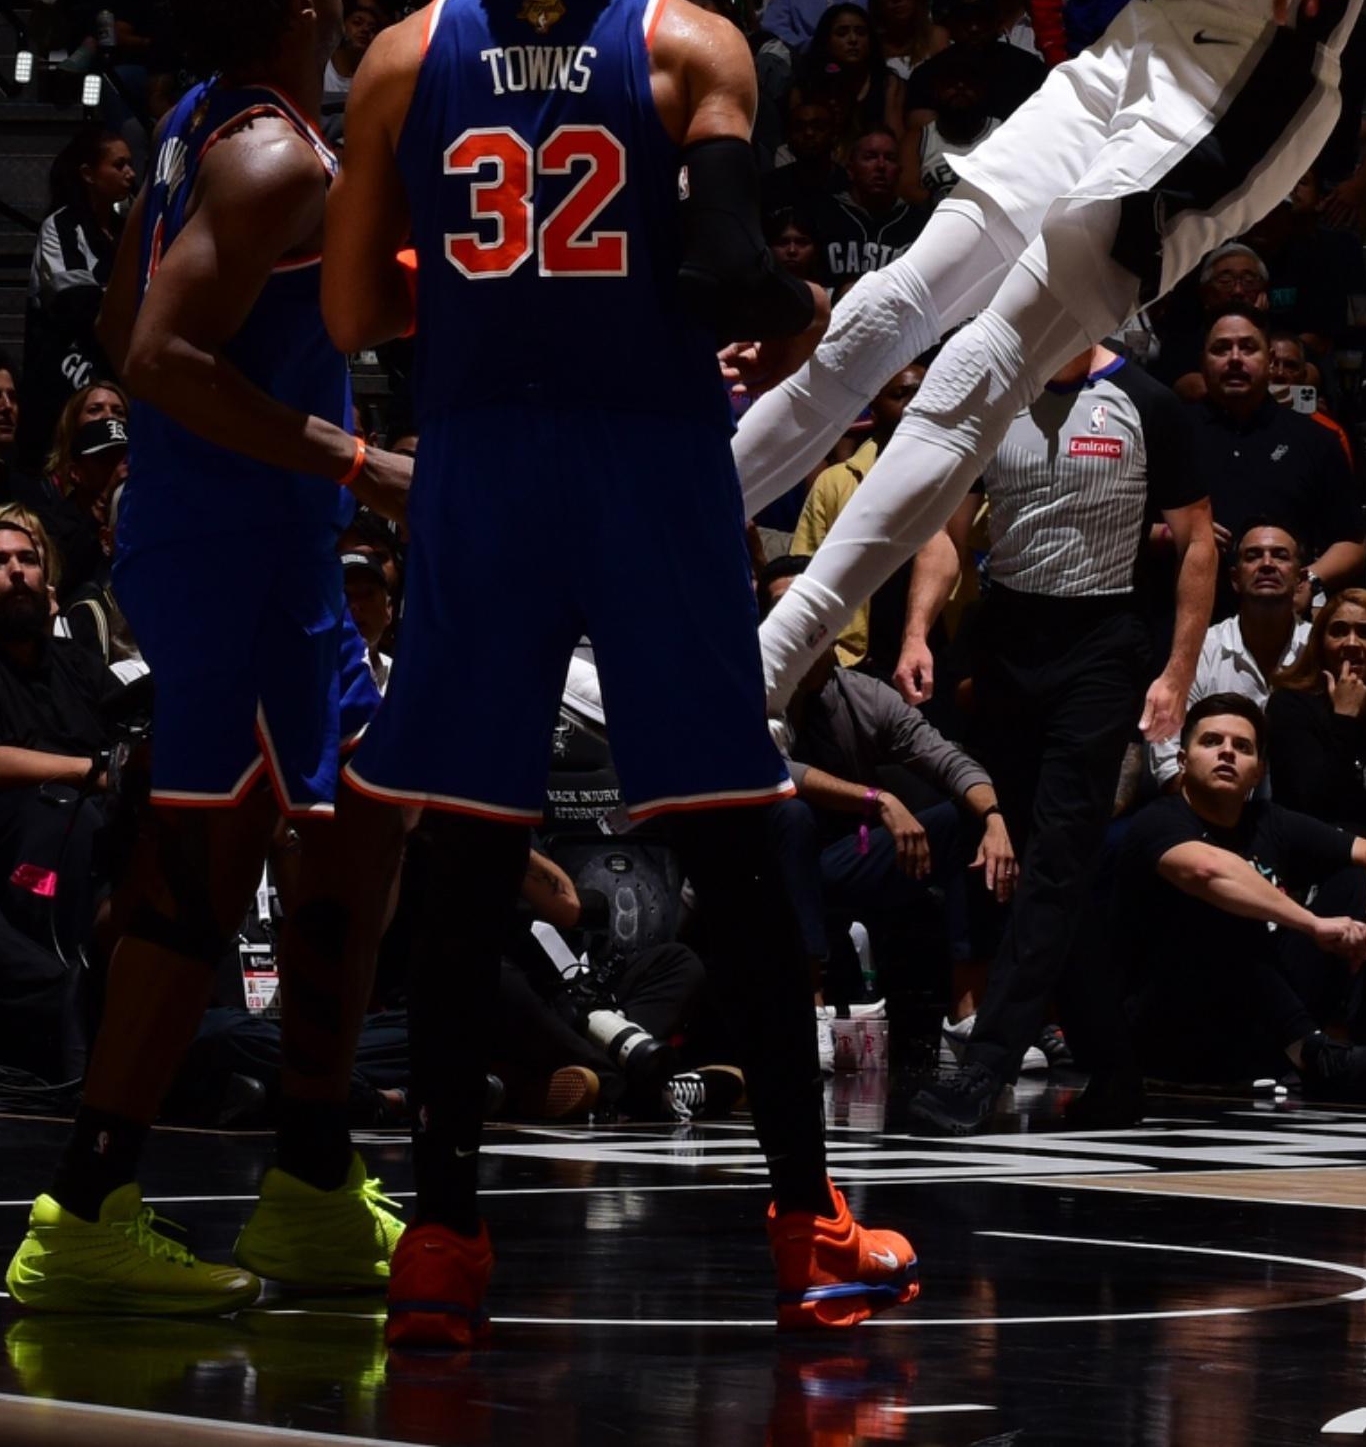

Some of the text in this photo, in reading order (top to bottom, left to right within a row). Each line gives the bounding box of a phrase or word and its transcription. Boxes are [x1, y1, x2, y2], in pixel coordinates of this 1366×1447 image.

[480, 45, 598, 96] TOWNS
[444, 125, 628, 280] 32
[828, 240, 910, 275] CAST
[1070, 440, 1122, 454] Emirates
[554, 805, 618, 820] ATTORNE
